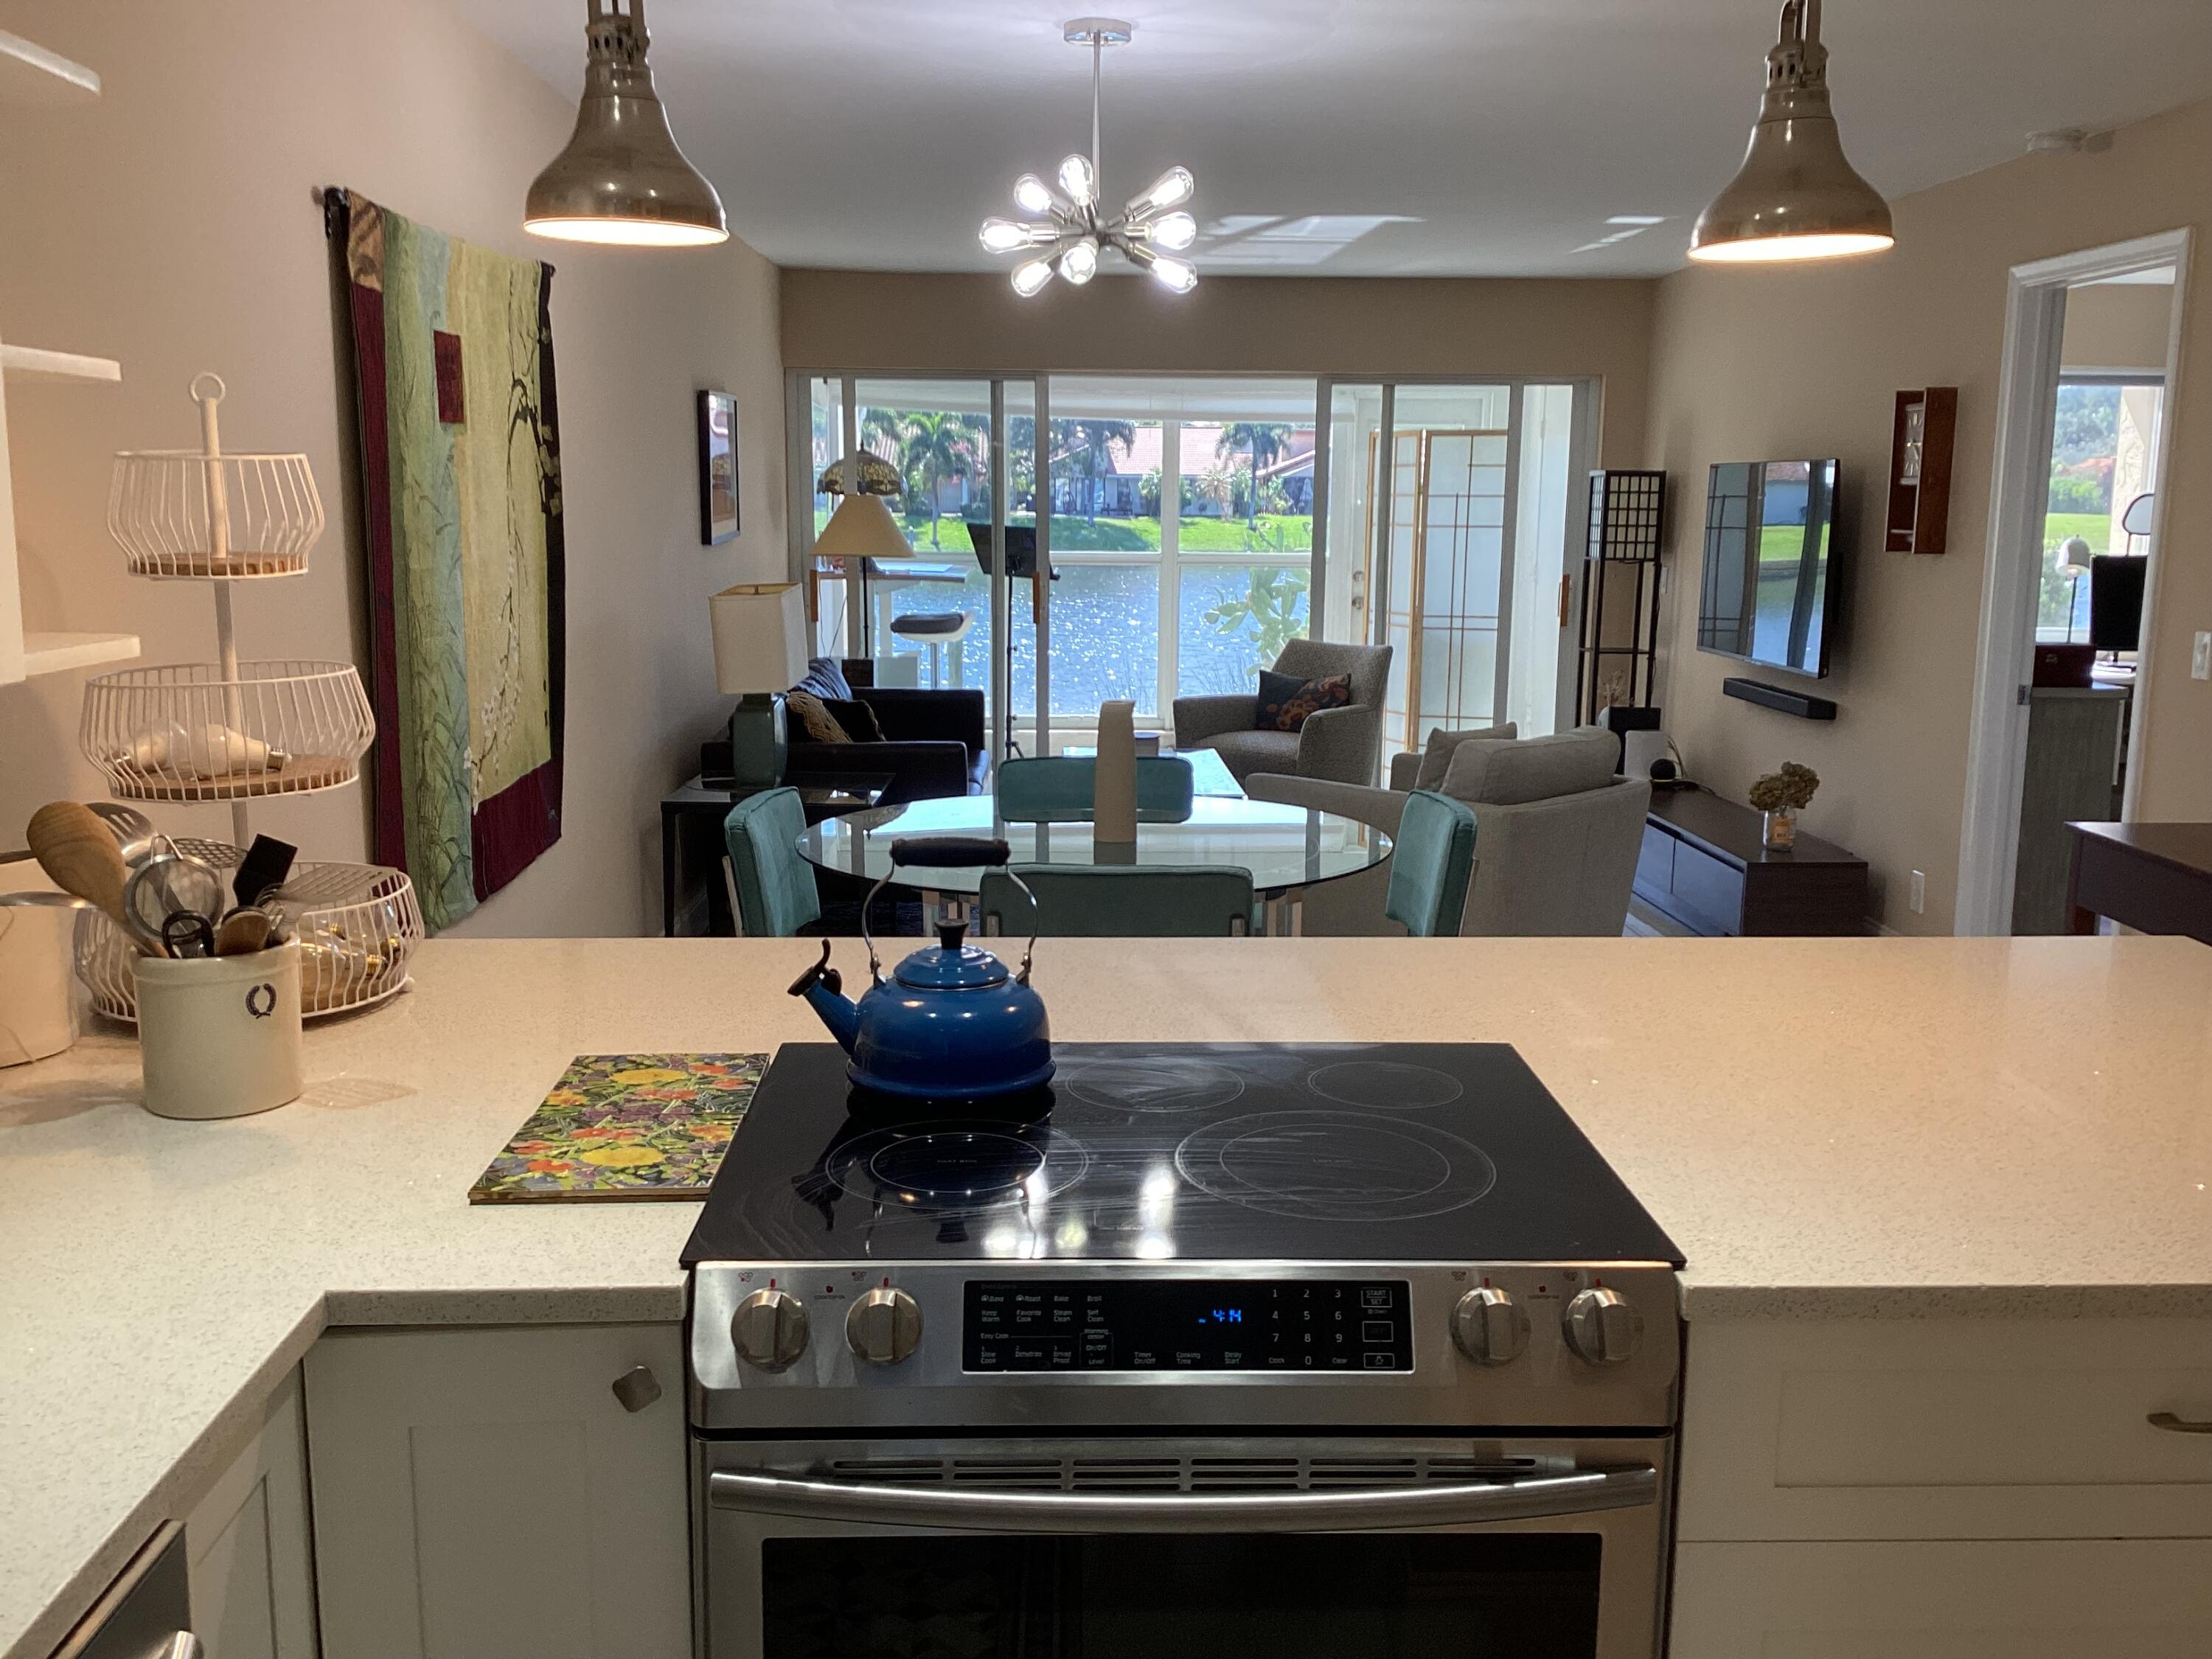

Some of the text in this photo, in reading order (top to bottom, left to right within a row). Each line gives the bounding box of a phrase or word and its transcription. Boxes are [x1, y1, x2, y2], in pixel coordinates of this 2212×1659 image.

[1273, 1289, 1278, 1298] 1
[1303, 1289, 1310, 1298] 2
[1335, 1289, 1341, 1298] 3
[1272, 1310, 1279, 1320] 4
[1304, 1310, 1310, 1321] 5
[1335, 1310, 1342, 1321] 6
[1272, 1332, 1279, 1343] 7
[1304, 1333, 1312, 1343] 8
[1335, 1333, 1343, 1343] 9
[1304, 1355, 1312, 1366] 0
